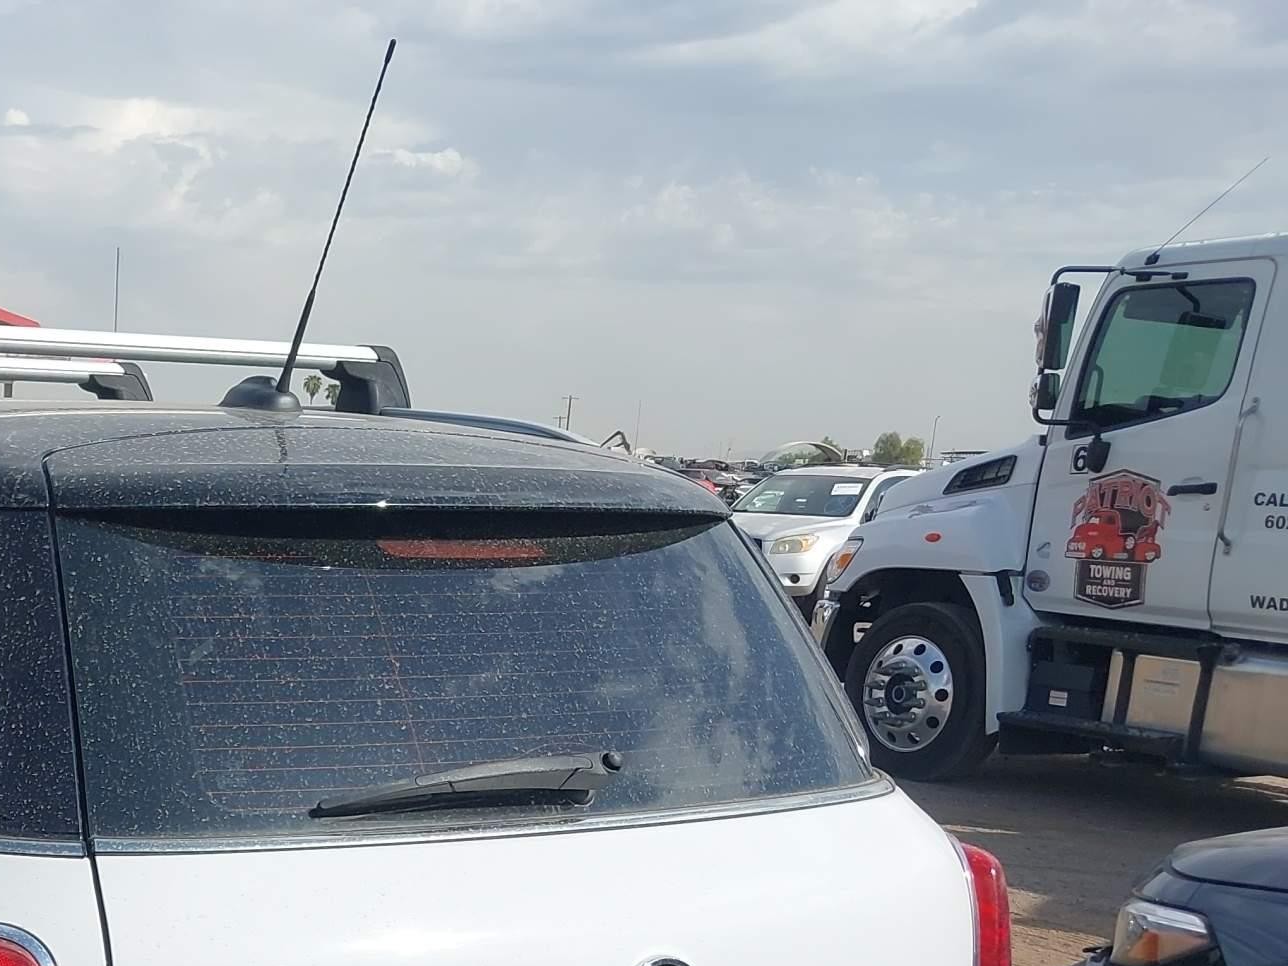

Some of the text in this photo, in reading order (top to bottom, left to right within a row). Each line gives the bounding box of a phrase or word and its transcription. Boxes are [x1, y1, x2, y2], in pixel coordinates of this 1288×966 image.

[1070, 475, 1171, 531] PATRIOT
[1089, 564, 1132, 581] TOWING
[1085, 584, 1132, 598] RECOVERY
